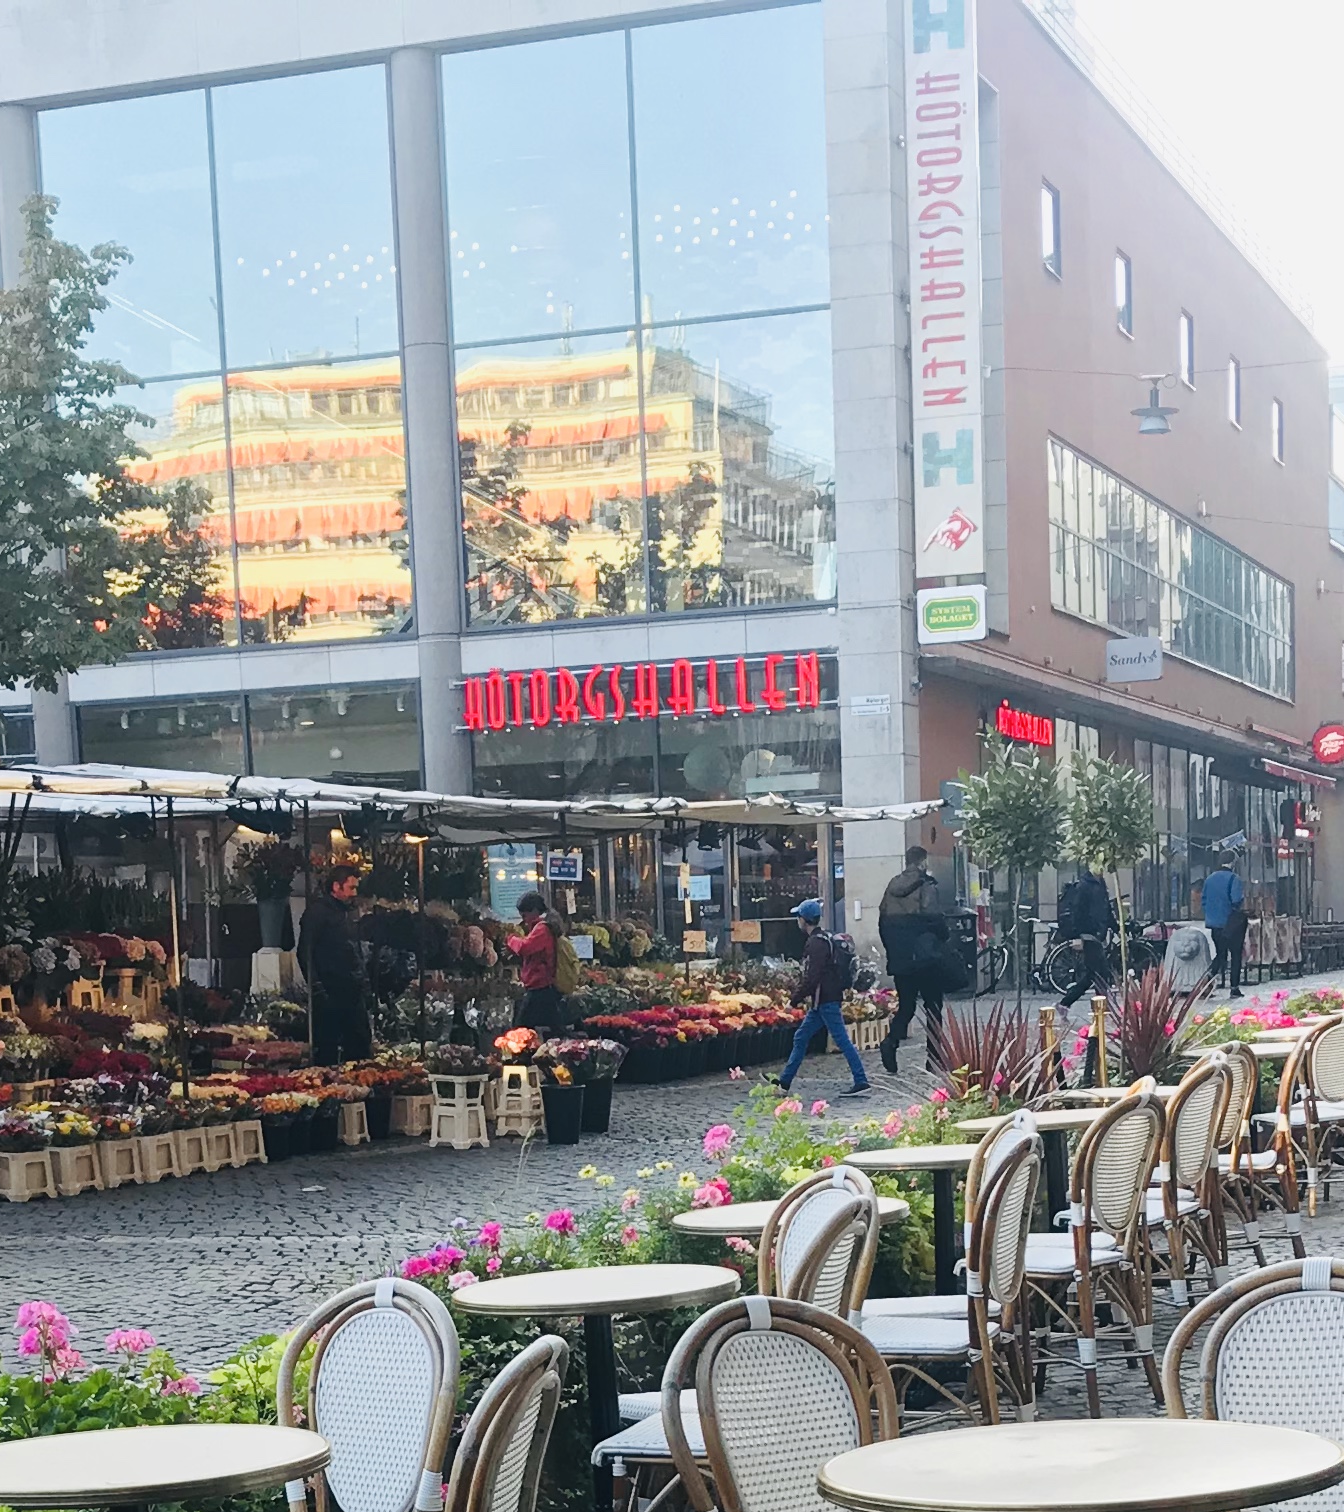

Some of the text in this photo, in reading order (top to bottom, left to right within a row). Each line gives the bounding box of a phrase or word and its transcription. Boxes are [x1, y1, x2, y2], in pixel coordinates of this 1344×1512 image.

[915, 71, 969, 408] HÖTORGSHALLEN
[928, 613, 975, 624] BOLAGET
[930, 604, 971, 616] SYSTEM
[462, 651, 820, 731] HÖTORGSHALLEN
